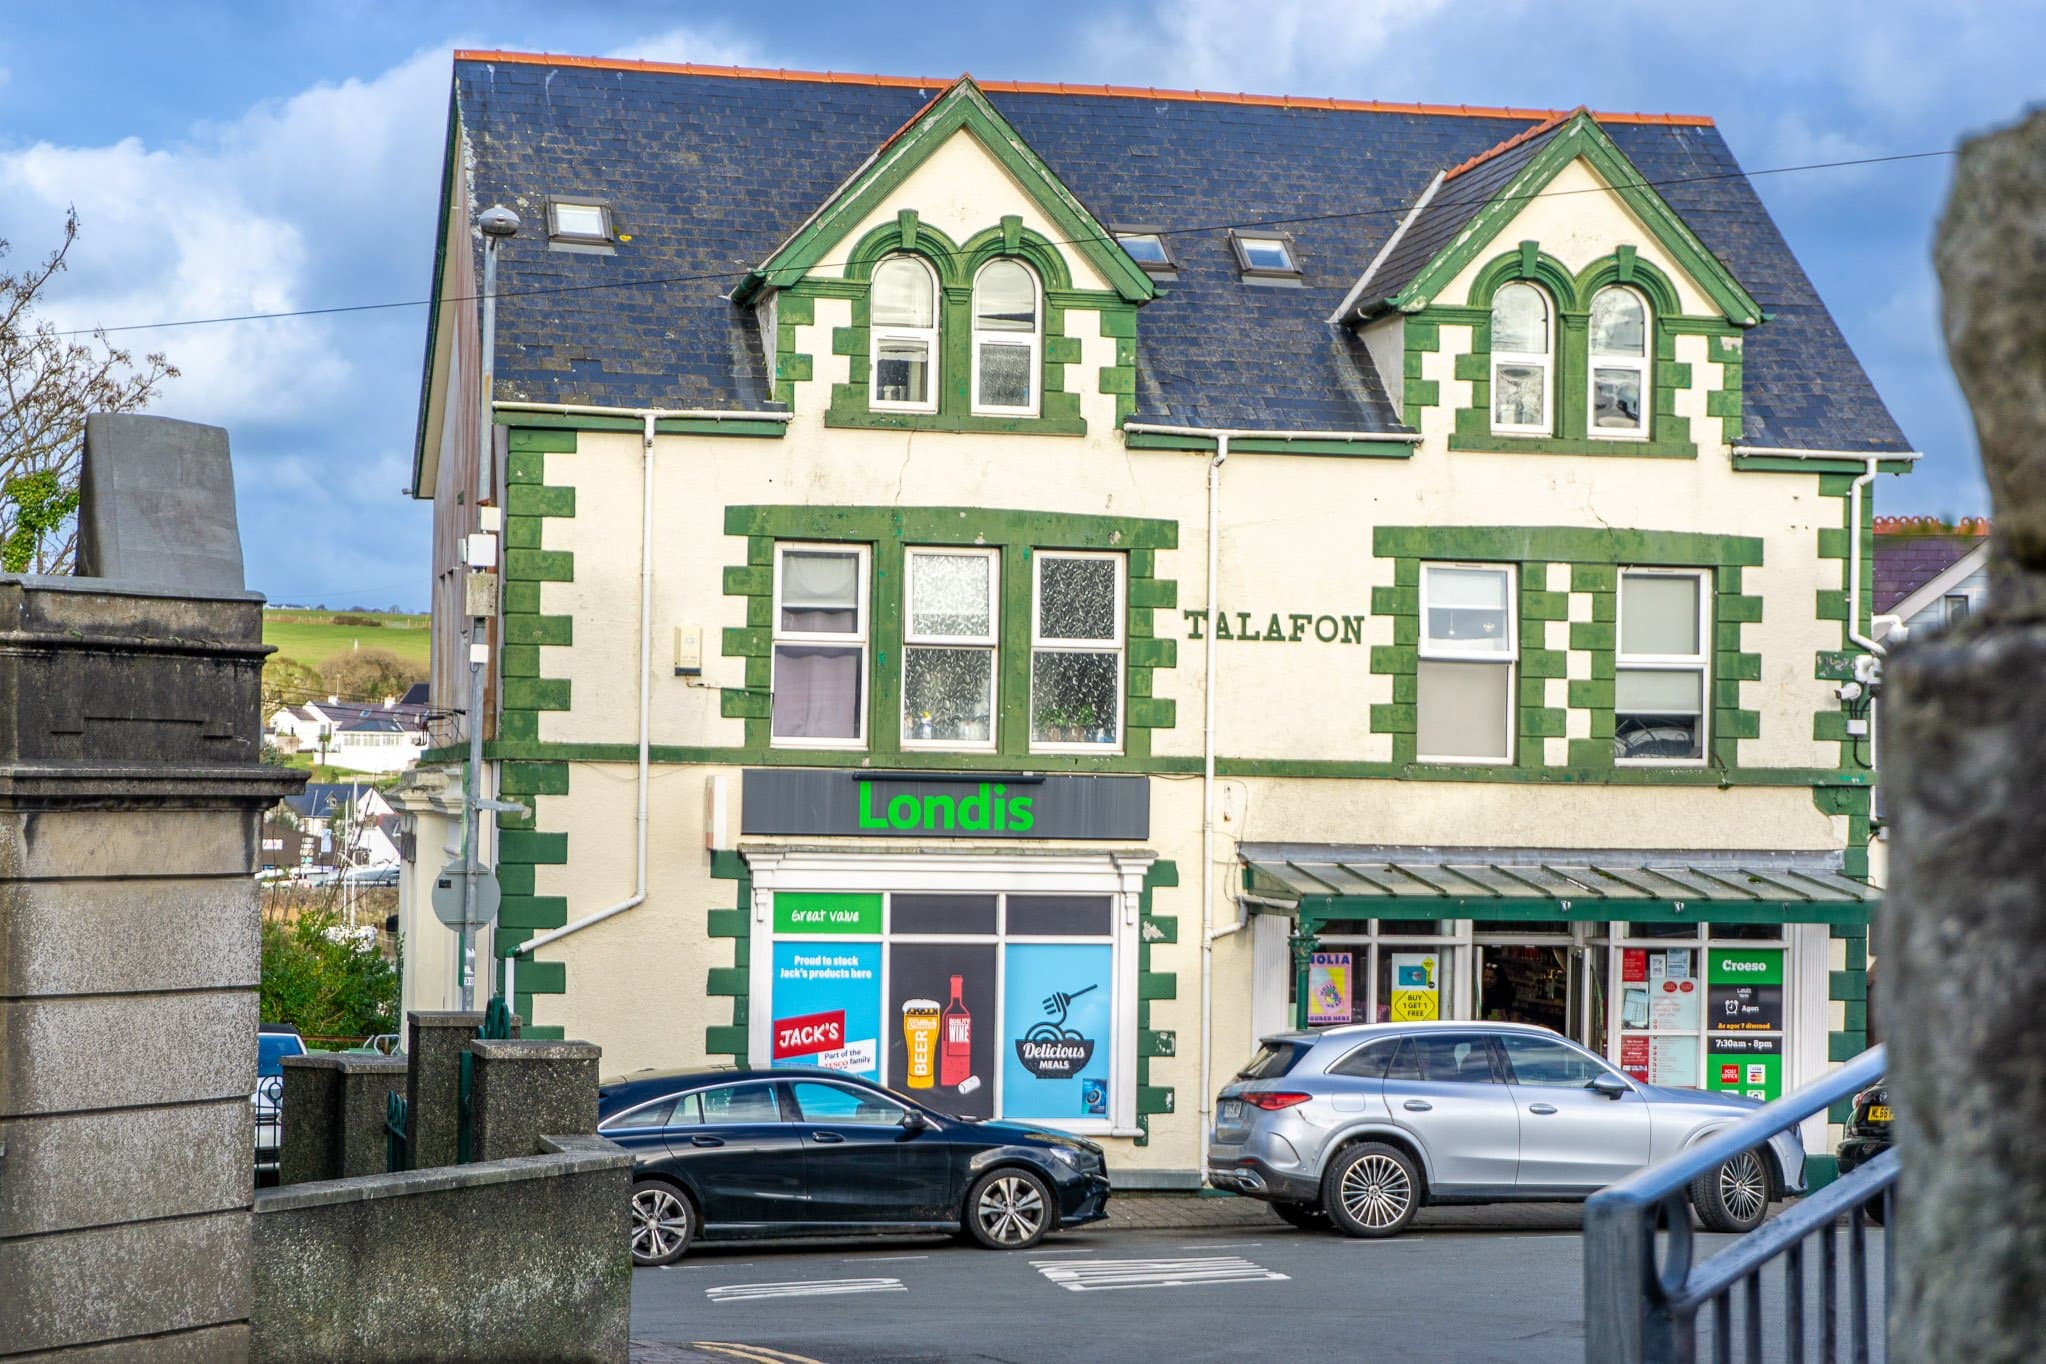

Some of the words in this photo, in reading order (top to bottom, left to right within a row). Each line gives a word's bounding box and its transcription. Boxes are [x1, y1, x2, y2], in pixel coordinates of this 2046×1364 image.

[1184, 610, 1365, 645] TALAFON
[859, 781, 1035, 832] Londis
[791, 909, 827, 922] Great
[829, 909, 860, 922] value
[794, 955, 821, 966] Proud
[822, 956, 832, 966] to
[833, 956, 859, 966] stock
[1722, 960, 1767, 972] Croeso
[780, 968, 808, 978] Jack's
[809, 968, 850, 980] products
[851, 968, 872, 978] here
[779, 1022, 839, 1048] JACK'S
[949, 1024, 970, 1043] WINE
[1023, 1042, 1086, 1058] Delicious
[1715, 1039, 1747, 1048] 7:30am
[1753, 1039, 1773, 1050] 8pm
[824, 1051, 839, 1060] Part
[849, 1048, 861, 1057] the
[914, 1030, 928, 1077] BEER
[825, 1061, 849, 1069] TESCO
[849, 1055, 871, 1065] family
[1039, 1060, 1070, 1070] MEALS
